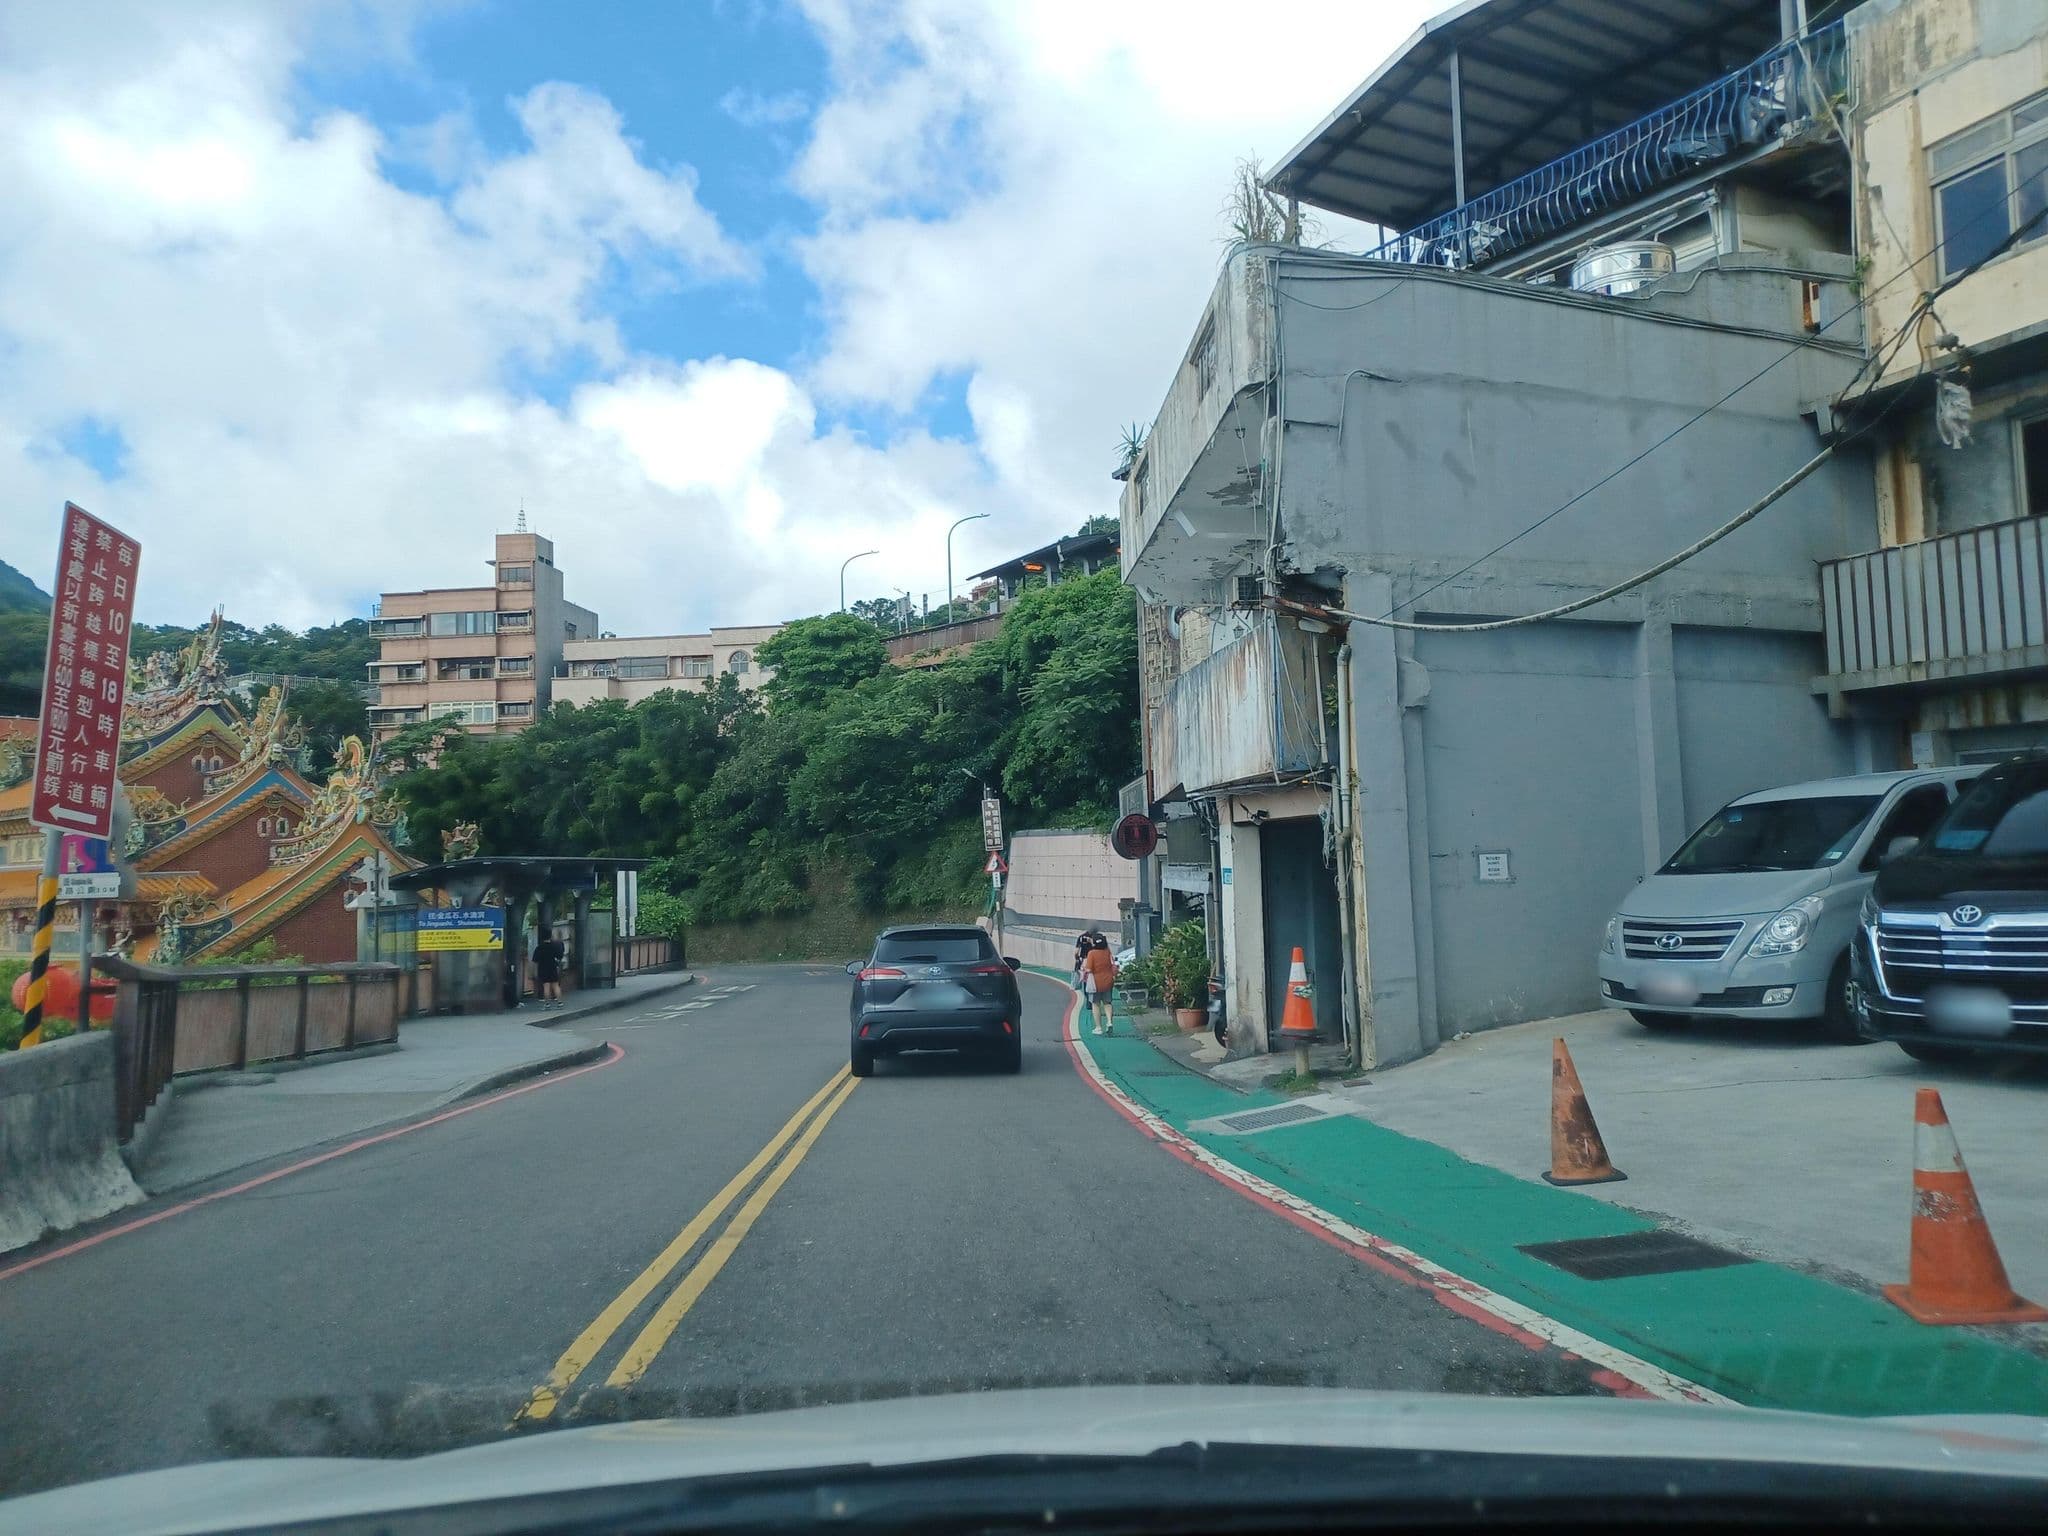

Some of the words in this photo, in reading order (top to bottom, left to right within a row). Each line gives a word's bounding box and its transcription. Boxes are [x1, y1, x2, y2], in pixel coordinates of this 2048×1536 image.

[67, 529, 114, 804] 禁止跨越標線型人行道
[89, 541, 133, 809] 每日10至18時車輛
